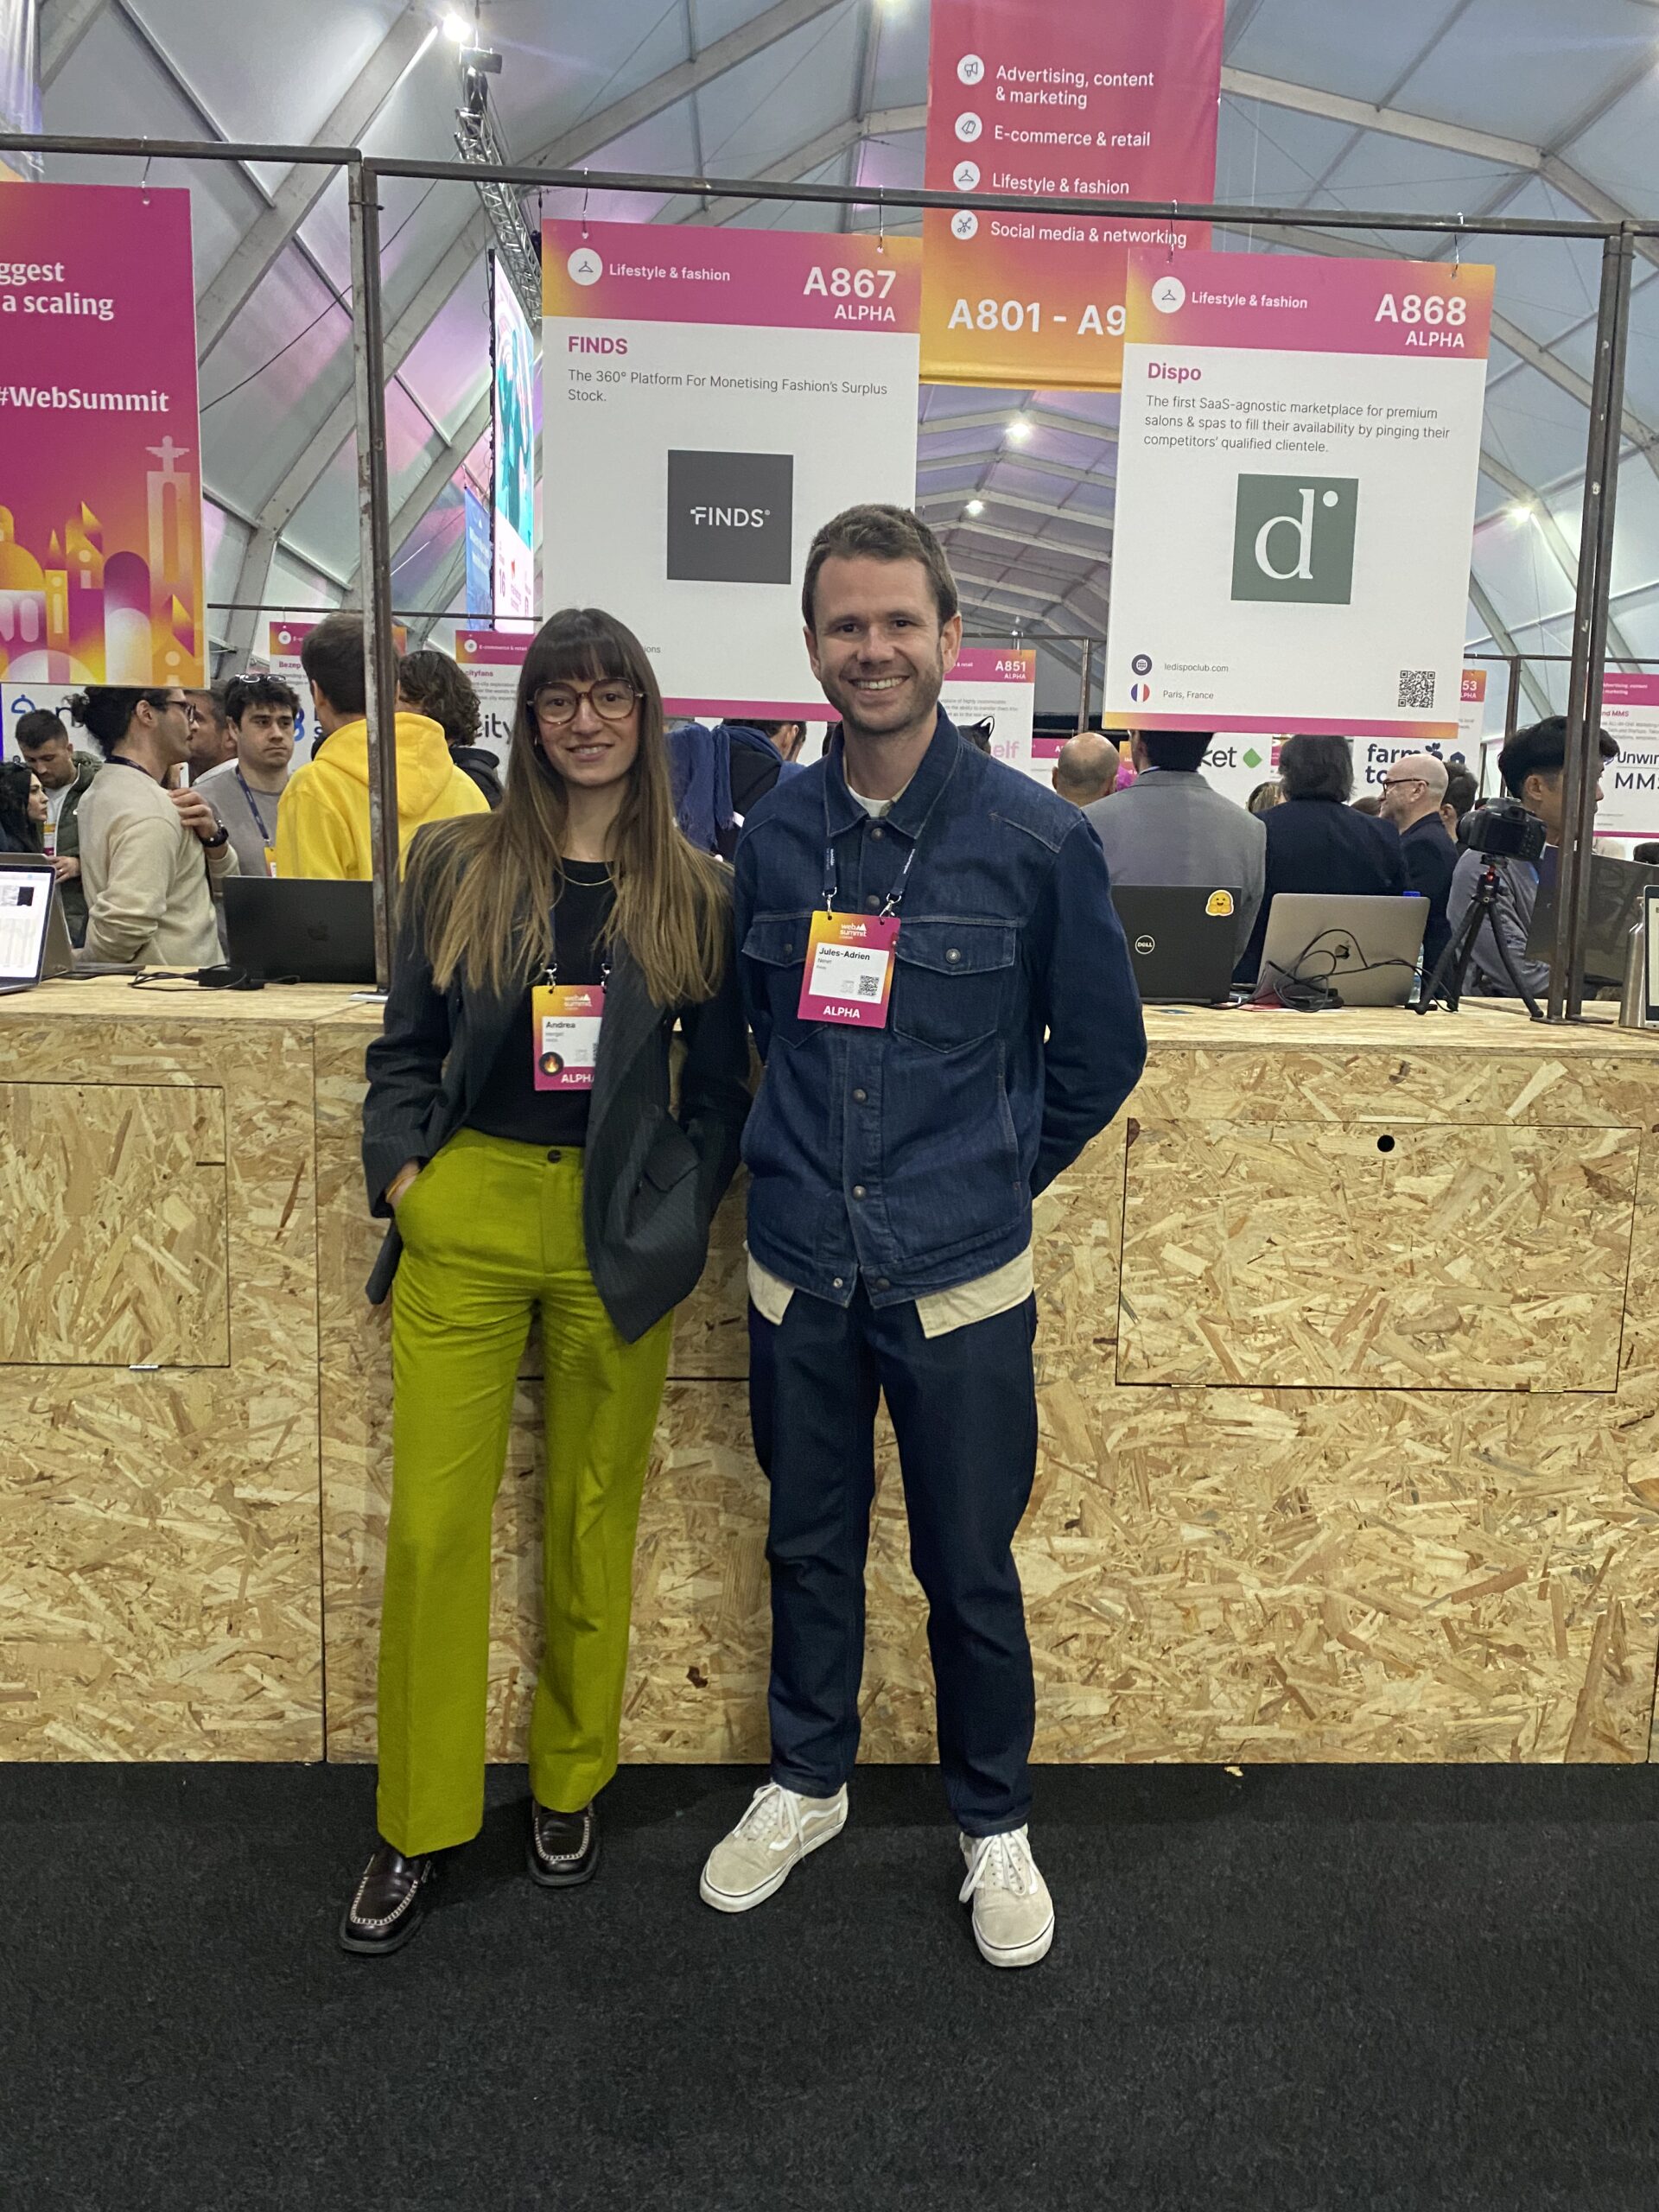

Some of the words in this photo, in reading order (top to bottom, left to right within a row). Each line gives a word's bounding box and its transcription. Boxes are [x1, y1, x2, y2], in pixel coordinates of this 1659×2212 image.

[996, 65, 1089, 88] Advertising,
[1094, 71, 1154, 86] content
[995, 86, 1006, 101] &
[1009, 89, 1088, 109] marketing
[995, 125, 1092, 145] E-commerce
[1096, 131, 1107, 146] &
[1111, 131, 1151, 147] retail
[992, 173, 1055, 193] Lifestyle
[1059, 178, 1071, 192] &
[1074, 178, 1130, 194] fashion
[990, 222, 1035, 239] Social
[1039, 225, 1085, 241] media
[1089, 227, 1099, 242] &
[1103, 228, 1187, 248] networking
[609, 264, 666, 280] Lifestyle
[669, 267, 678, 278] &
[681, 266, 731, 281] fashion
[803, 266, 897, 299] A867
[2, 295, 16, 312] a
[23, 292, 115, 321] scaling
[1192, 291, 1247, 308] Lifestyle
[1249, 294, 1258, 306] &
[1261, 295, 1308, 308] fashion
[834, 303, 896, 322] ALPHA
[947, 298, 1040, 333] A801
[1374, 294, 1467, 326] A868
[567, 335, 628, 355] FINDS
[1405, 330, 1465, 348] ALPHA
[568, 369, 592, 382] The
[595, 371, 626, 383] 360°
[631, 372, 683, 385] Platform
[686, 374, 707, 386] For
[710, 375, 779, 393] Monetising
[782, 378, 838, 393] Fashion's
[842, 381, 888, 397] Surplus
[1147, 361, 1202, 385] Dispo
[0, 385, 169, 412] #WebSummit
[568, 389, 607, 402] Stock.
[1146, 395, 1169, 407] The
[1173, 396, 1196, 408] first
[1199, 397, 1287, 414] SaaS-agnostic
[1290, 403, 1363, 416] marketplace
[1367, 404, 1383, 416] for
[1386, 407, 1438, 420] premium
[1144, 415, 1183, 427] salons
[1186, 416, 1195, 428] &
[1198, 418, 1227, 430] spas
[1230, 418, 1243, 429] to
[1245, 417, 1259, 430] fill
[1262, 419, 1290, 432] their
[1293, 422, 1355, 437] availability
[1358, 423, 1373, 438] by
[1376, 425, 1420, 440] pinging
[1423, 427, 1450, 439] their
[1143, 435, 1218, 448] competitors'
[1221, 437, 1272, 450] qualified
[1275, 439, 1329, 453] clientele.
[995, 660, 1027, 672] A851
[1164, 663, 1229, 673] ledispoclub.com
[1163, 690, 1185, 700] Paris,
[1186, 691, 1214, 700] France
[992, 740, 1020, 759] elf
[1615, 772, 1659, 790] MM
[818, 947, 870, 961] Jules-Adrien
[823, 1005, 861, 1019] ALPHA
